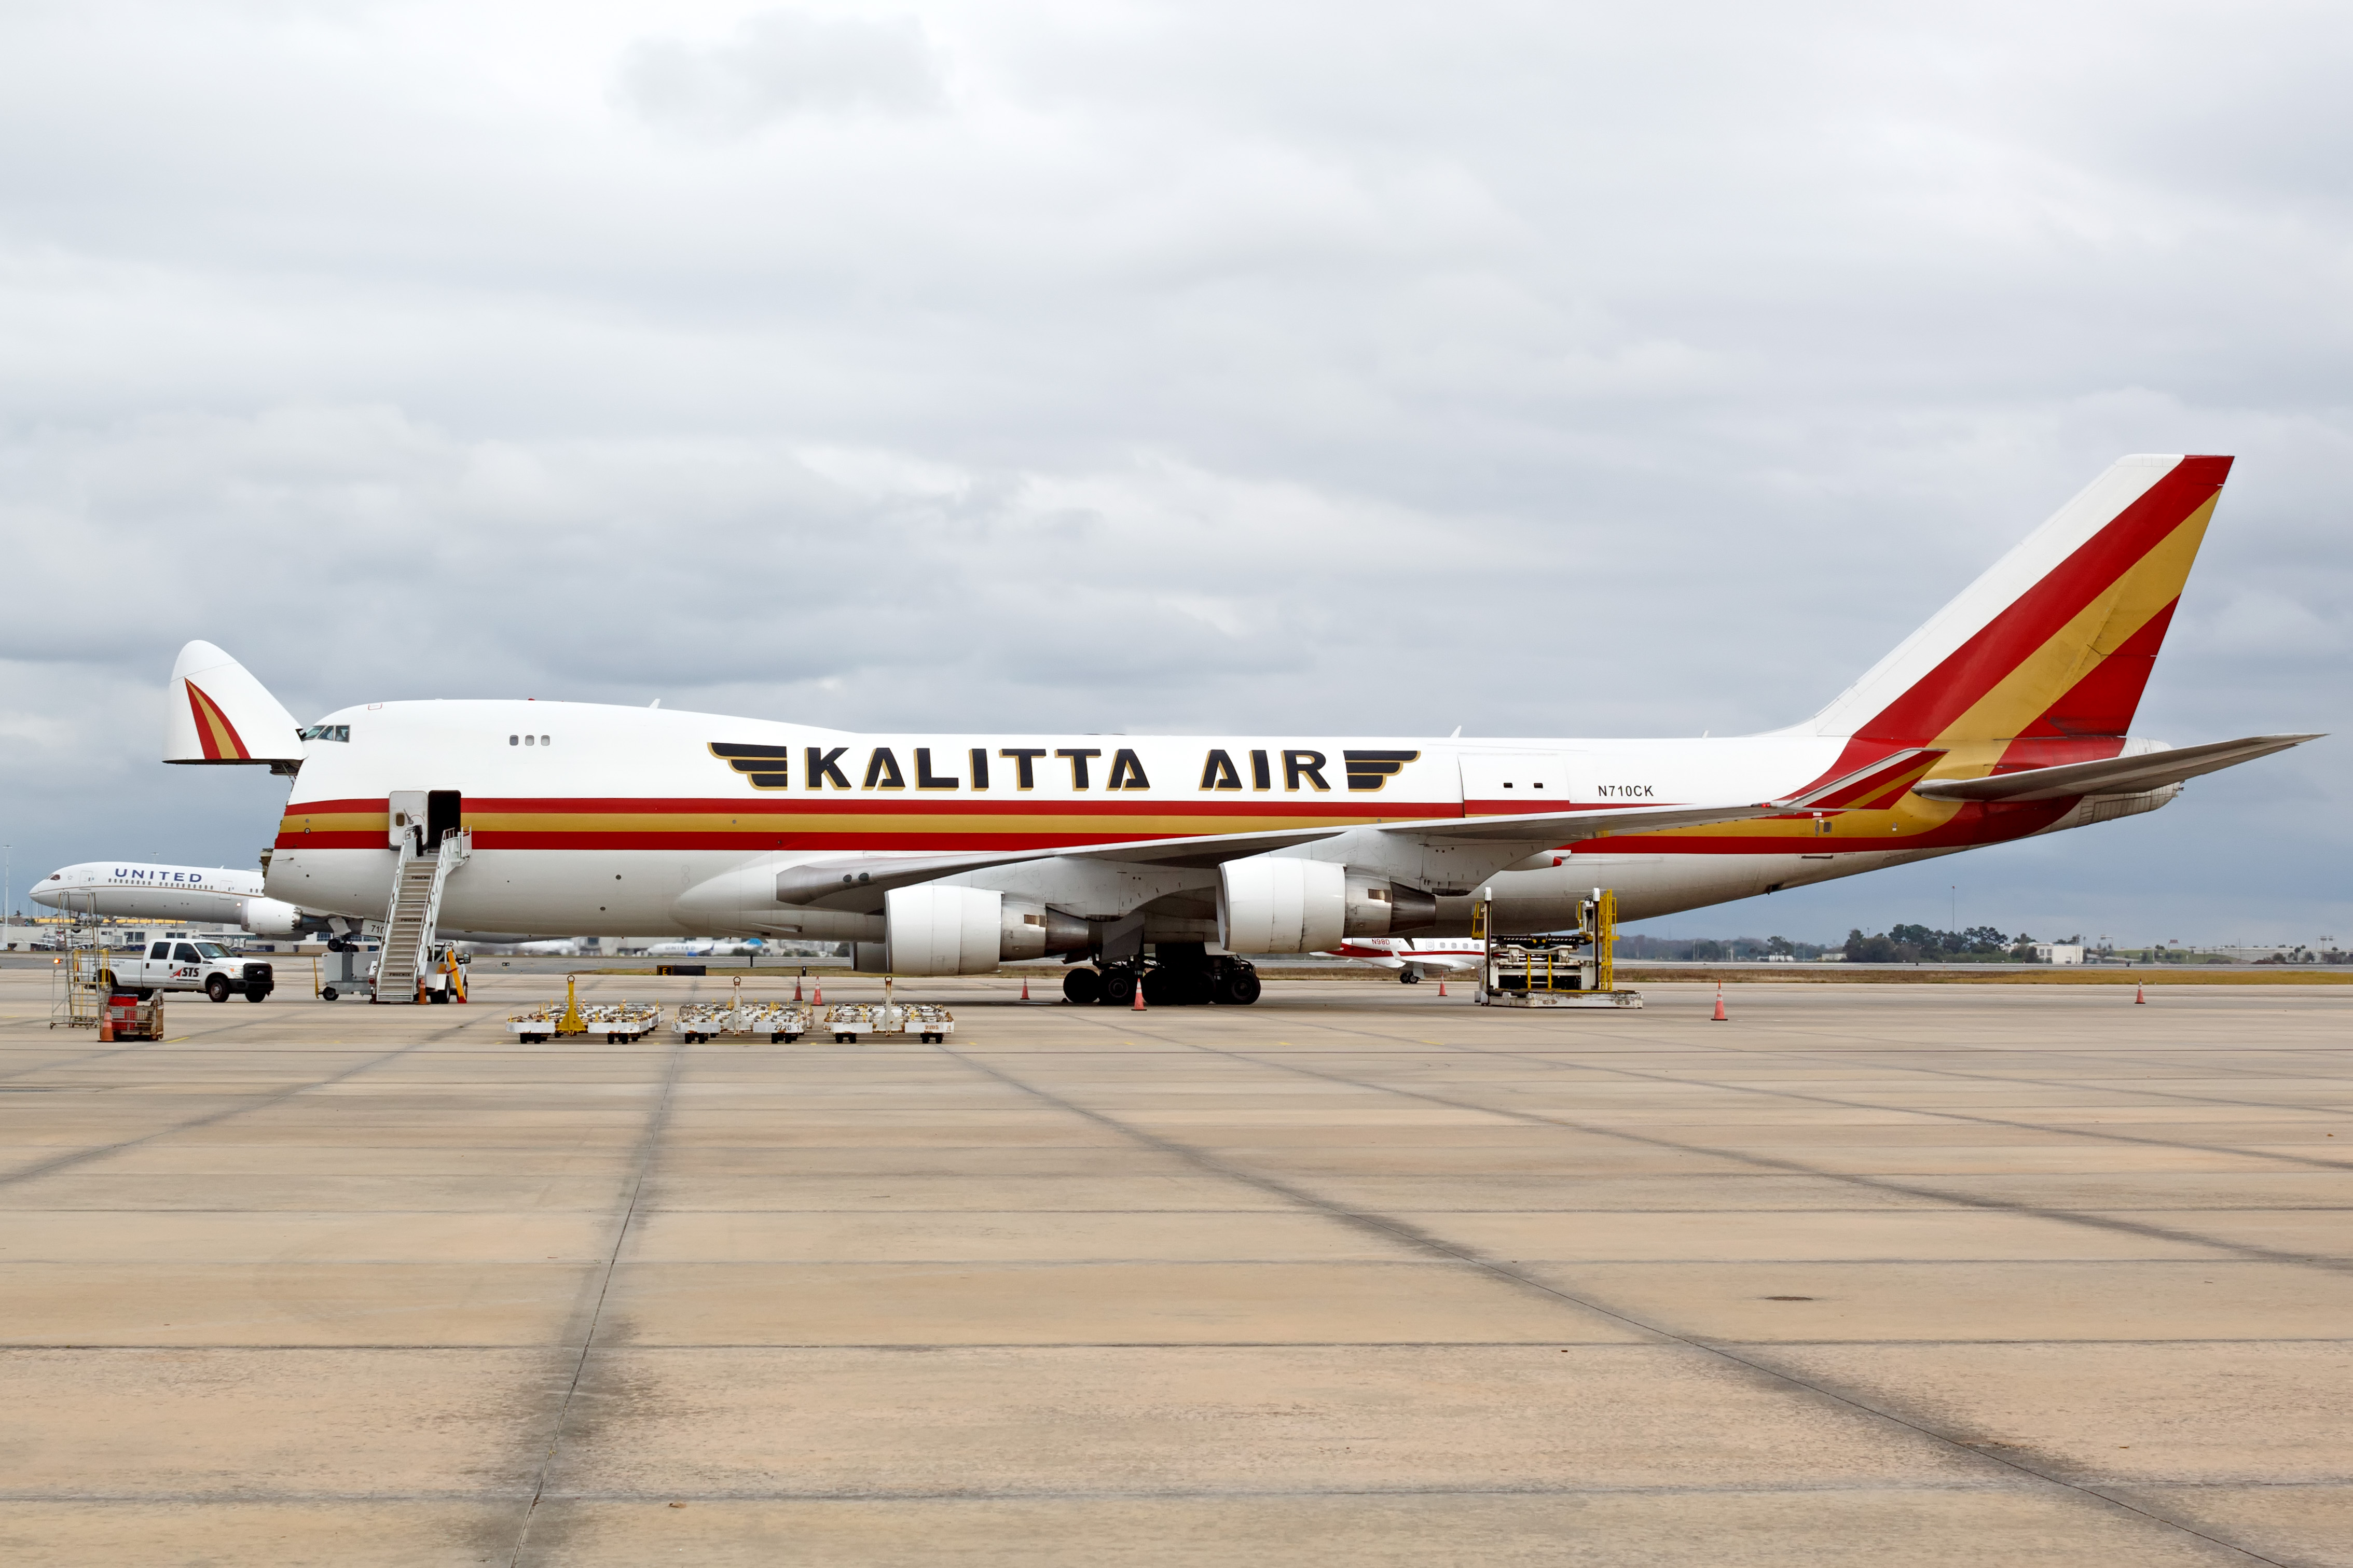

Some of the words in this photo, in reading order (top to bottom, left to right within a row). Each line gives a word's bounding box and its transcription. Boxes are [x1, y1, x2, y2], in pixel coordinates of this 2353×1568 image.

[804, 747, 1151, 792] KALITTA
[1198, 749, 1331, 792] AIR
[1598, 785, 1654, 797] N710CK
[115, 868, 202, 882] UNITED
[182, 967, 200, 977] STS
